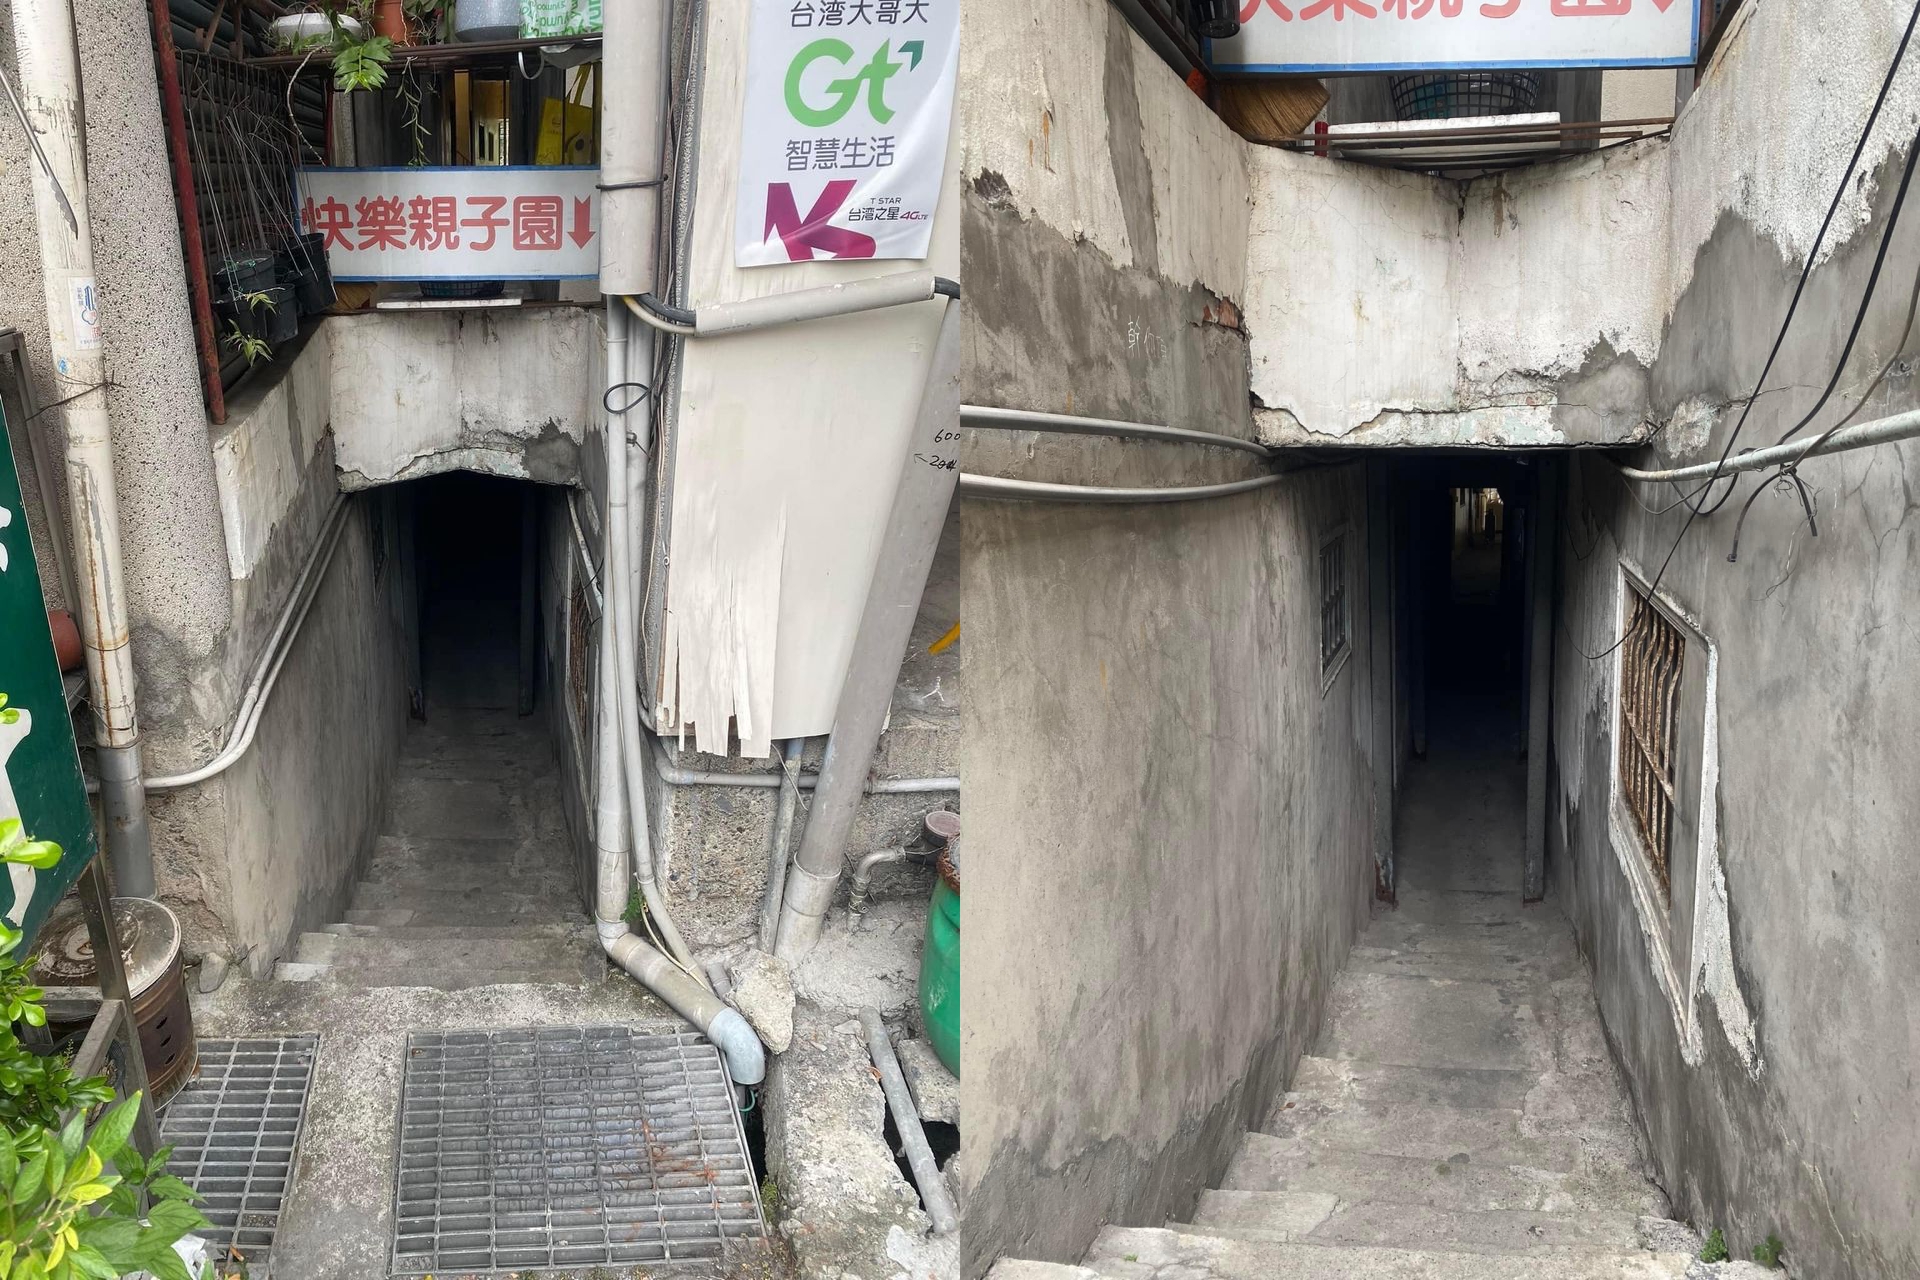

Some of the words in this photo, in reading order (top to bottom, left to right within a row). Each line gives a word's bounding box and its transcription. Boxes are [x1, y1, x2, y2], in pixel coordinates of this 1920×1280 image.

[785, 136, 895, 171] 智慧生活
[301, 195, 563, 251] 快樂親子園
[934, 429, 960, 443] 600
